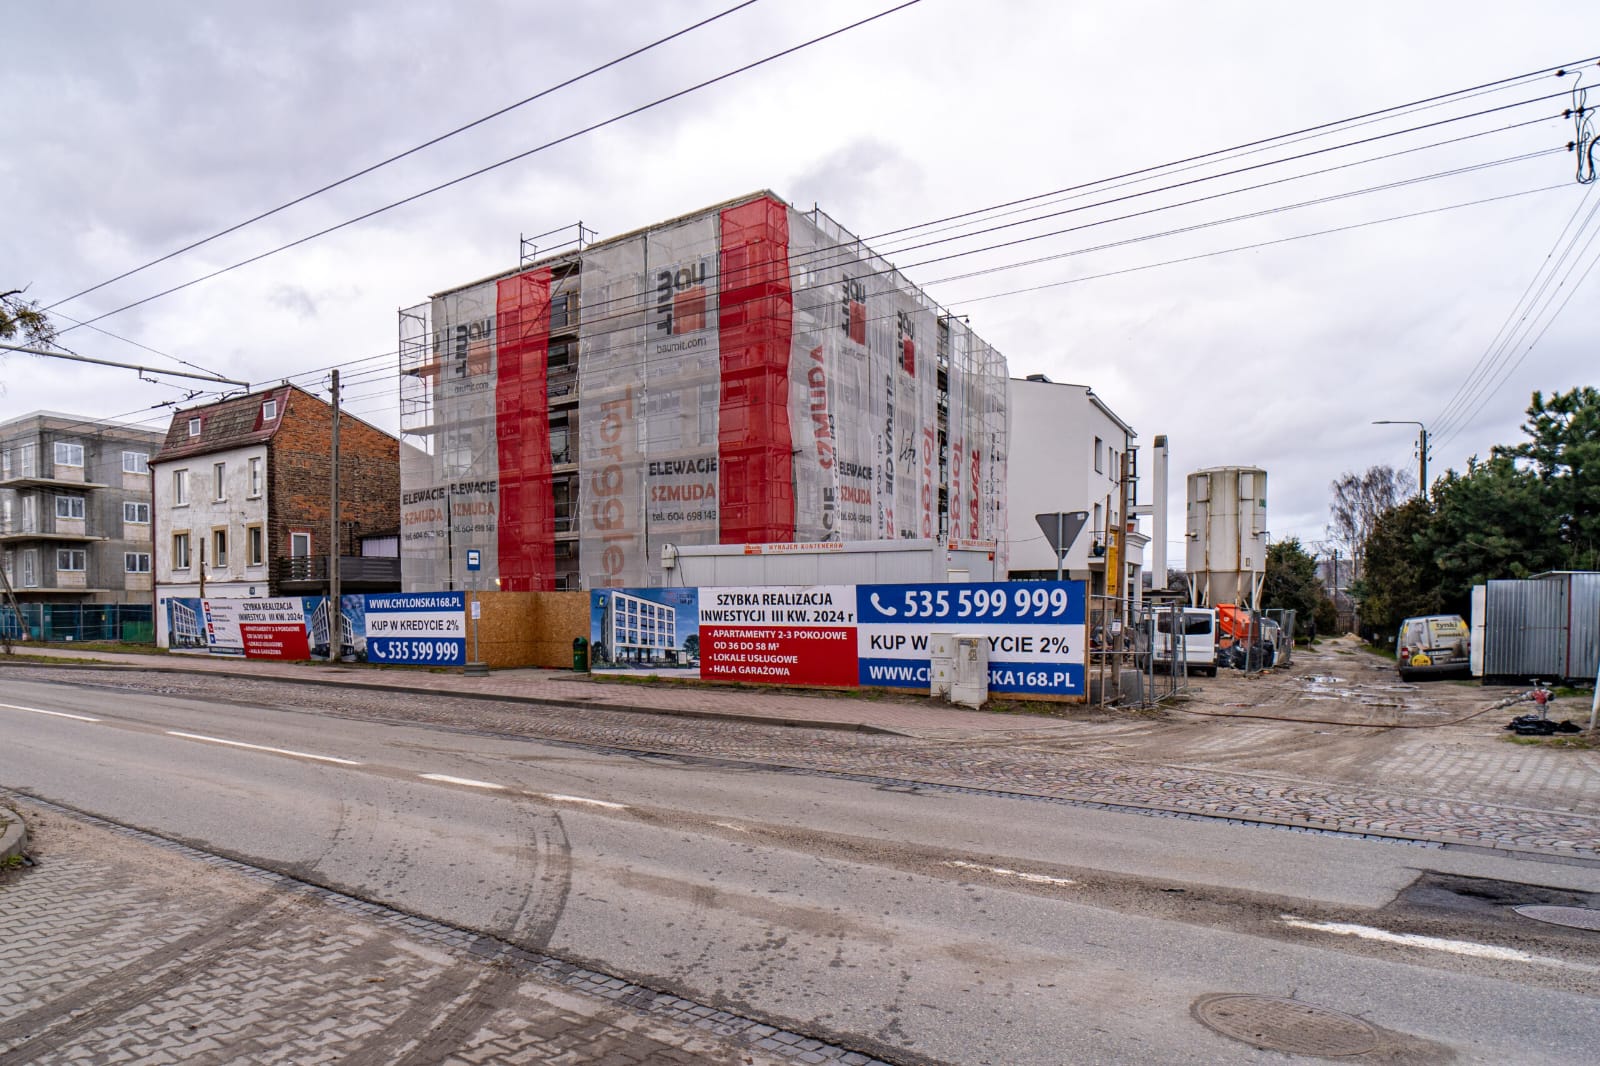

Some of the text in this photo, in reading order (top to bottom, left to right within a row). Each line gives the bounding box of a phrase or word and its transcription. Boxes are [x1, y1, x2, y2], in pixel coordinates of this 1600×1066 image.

[656, 337, 706, 353] baumit.com
[885, 373, 895, 495] ELEWACJE
[649, 457, 718, 476] ELEWACJE
[840, 461, 872, 481] ELEWACJE
[403, 487, 445, 505] ELEWACJE
[450, 481, 496, 495] ELEWACJE
[651, 483, 716, 502] SZMUDA
[840, 485, 871, 505] SZMUDA
[404, 508, 443, 526] SZMUDA
[453, 501, 496, 517] SZMUDA
[652, 512, 665, 521] tel.
[668, 512, 684, 520] 604
[687, 511, 702, 520] 698
[369, 597, 461, 609] WWW.CHYLONSKA168.PL
[717, 593, 833, 606] SZYBKA REALIZACJA
[904, 588, 1068, 617] 535 599 999
[701, 610, 853, 622] INWESTYCJI III KW. 2024 r
[371, 620, 459, 631] KUP W KREDYCIE 2%
[713, 630, 847, 640] APARTAMENTY 2-3 POKOJOWE
[388, 642, 459, 661] 535 599 999
[713, 642, 726, 650] OD
[728, 642, 738, 650] 36
[740, 642, 753, 650] DO
[871, 635, 905, 650] KUP
[911, 635, 928, 650] W
[987, 636, 1033, 652] YCIE
[1040, 637, 1069, 654] 2%
[713, 654, 798, 664] LOKALE USŁUGOWE
[714, 665, 790, 676] HALA GARAŻOWA
